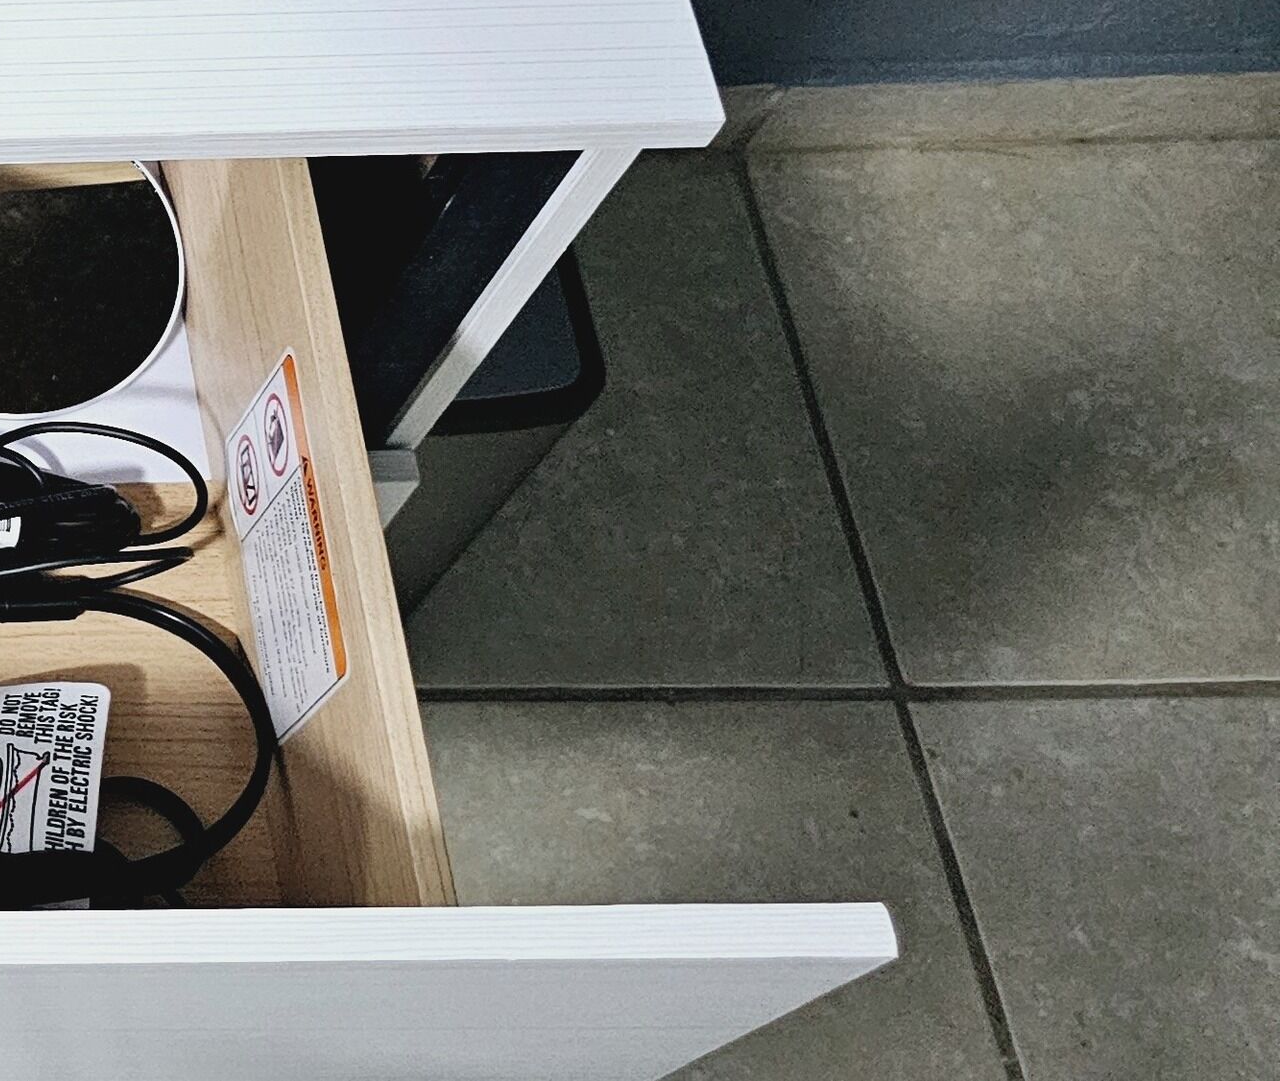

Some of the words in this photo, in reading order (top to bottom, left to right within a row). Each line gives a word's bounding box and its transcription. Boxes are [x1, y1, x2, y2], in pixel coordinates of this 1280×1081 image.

[306, 478, 327, 571] WARNING
[1, 694, 23, 715] NOT
[39, 688, 62, 712] TAG!
[15, 692, 41, 738] REMOVE
[34, 715, 56, 744] THIS
[56, 703, 78, 733] RISK
[75, 695, 100, 741] SHOCK!
[52, 735, 74, 761] THE
[50, 766, 70, 785] OF
[68, 746, 92, 814] ELECTRIC
[66, 817, 86, 839] BY
